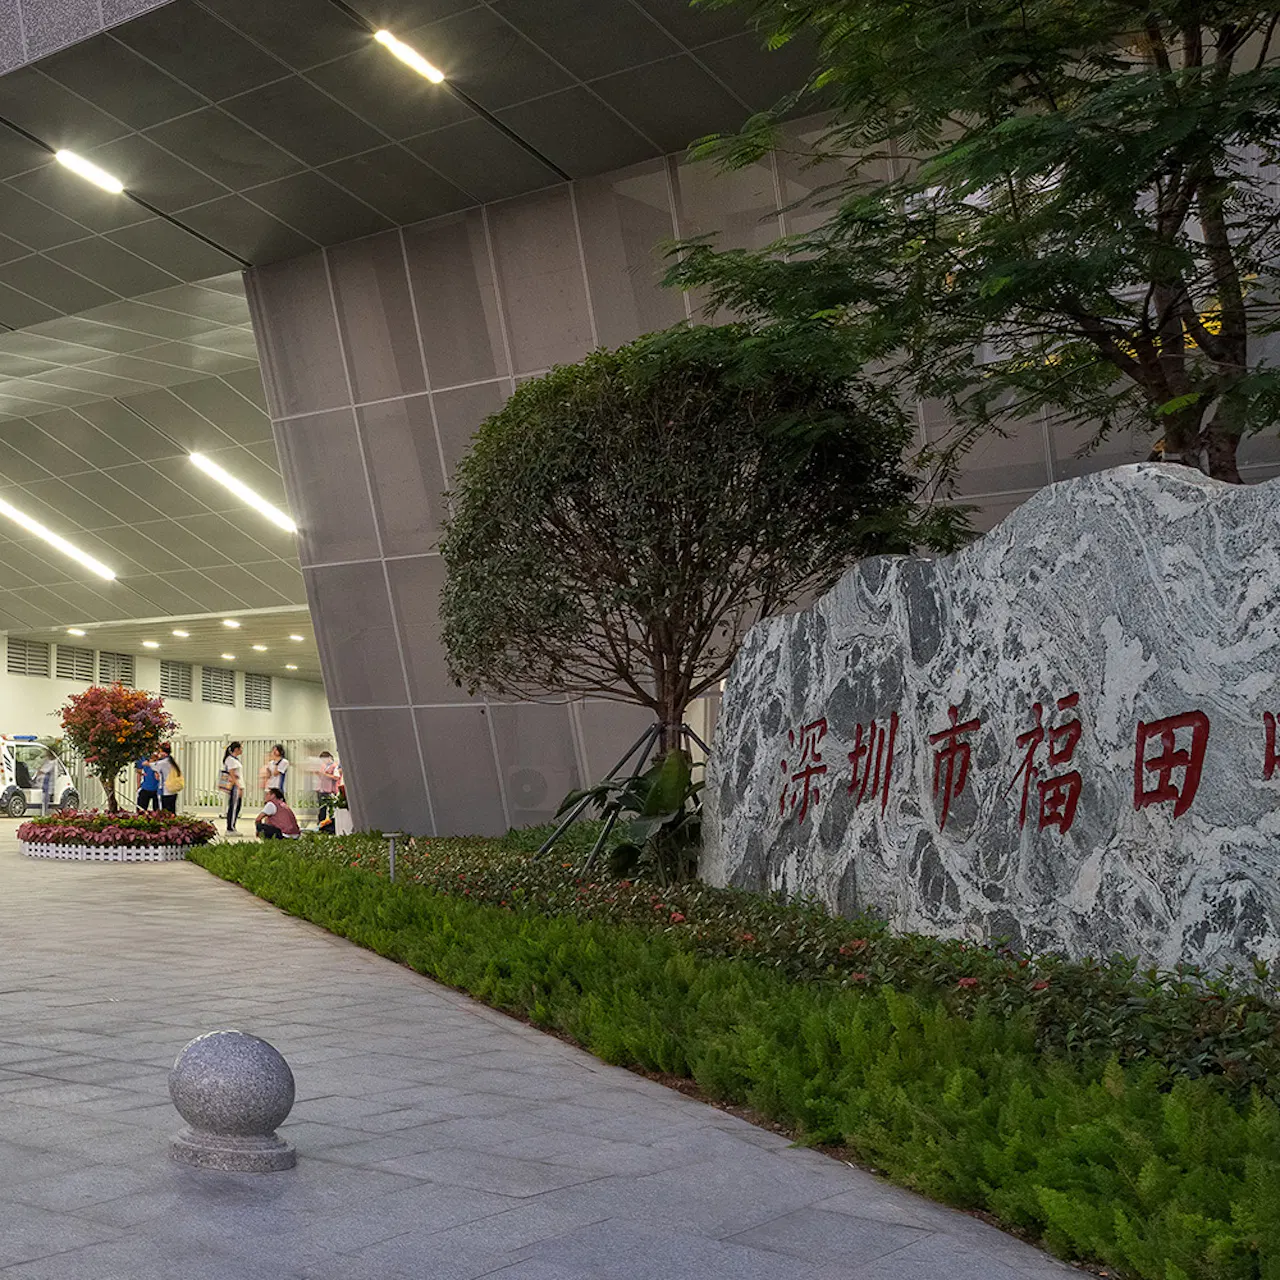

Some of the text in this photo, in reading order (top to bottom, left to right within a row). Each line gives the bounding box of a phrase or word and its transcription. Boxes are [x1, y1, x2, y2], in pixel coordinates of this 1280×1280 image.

[779, 692, 1280, 836] 深圳市福田
